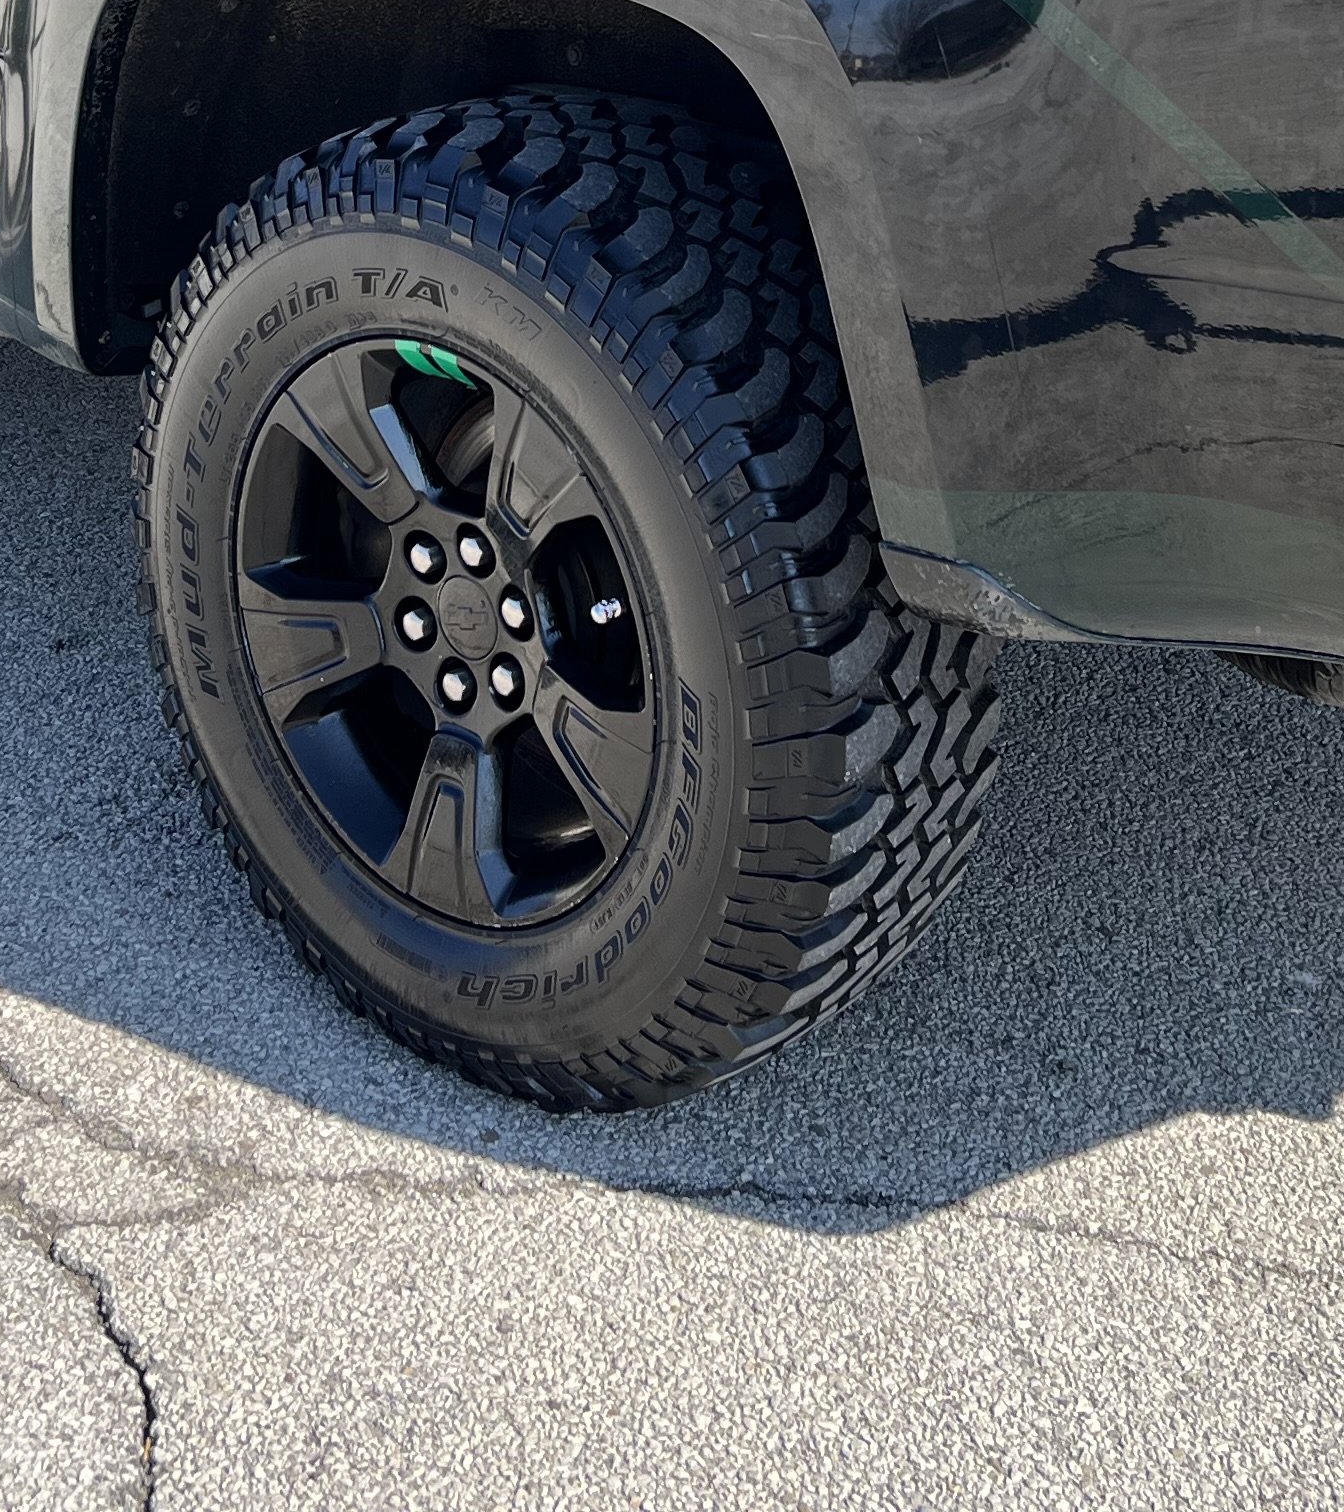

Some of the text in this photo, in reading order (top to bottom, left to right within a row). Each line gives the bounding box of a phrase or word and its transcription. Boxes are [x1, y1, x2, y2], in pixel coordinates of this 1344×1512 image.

[175, 276, 339, 704] Mud-Terrain
[352, 267, 449, 313] T/A
[457, 676, 702, 1011] BFGoodrich
